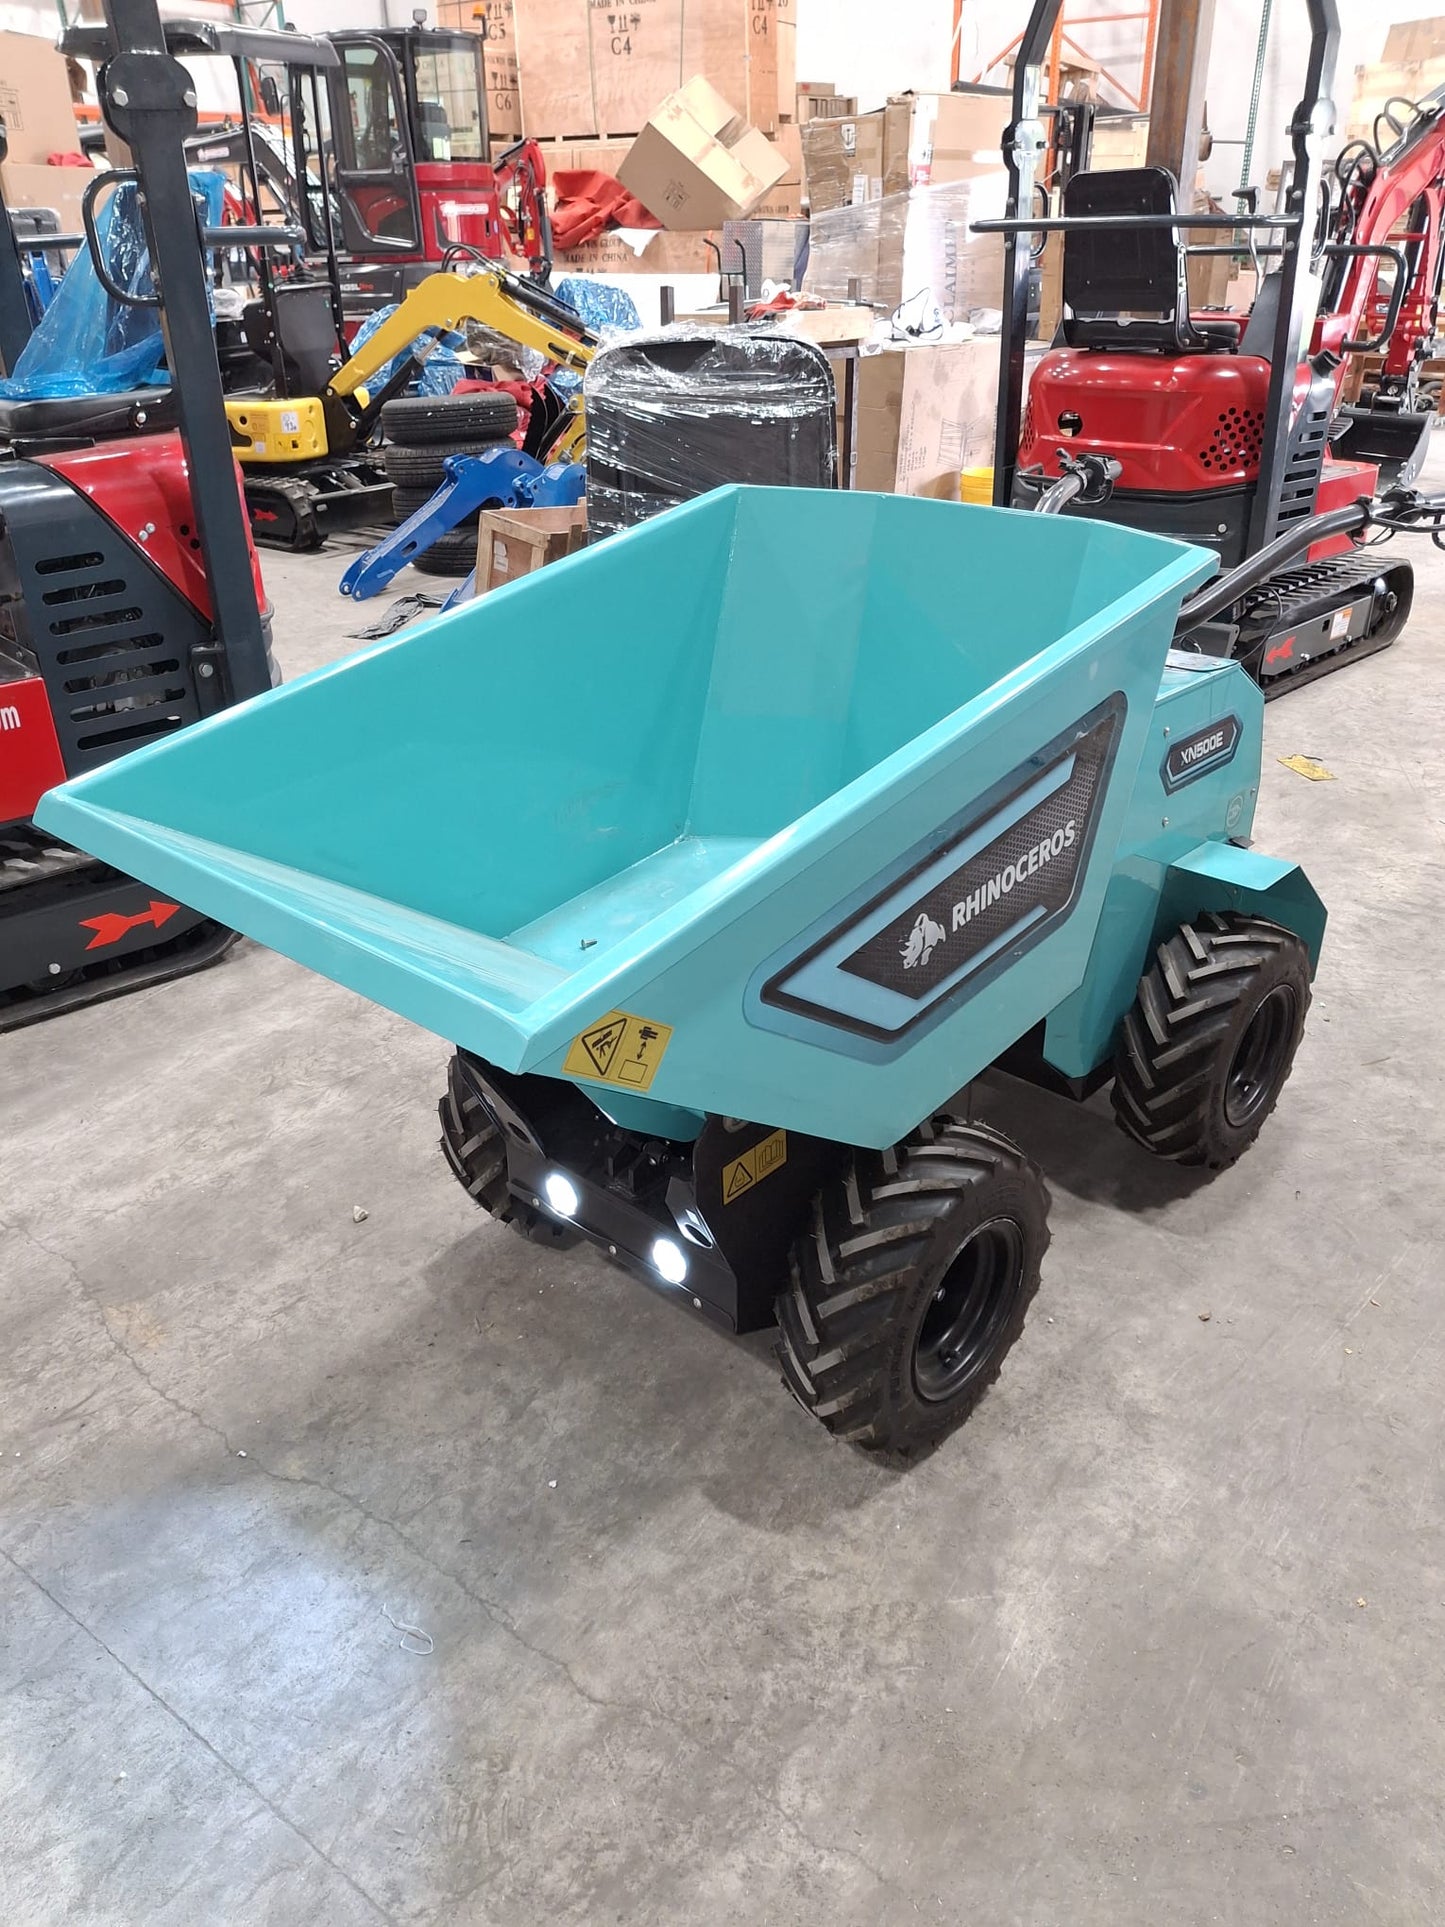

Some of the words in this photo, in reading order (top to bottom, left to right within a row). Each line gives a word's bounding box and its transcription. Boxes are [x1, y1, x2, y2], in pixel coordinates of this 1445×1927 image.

[488, 23, 506, 40] C5
[752, 15, 768, 35] C4
[611, 36, 632, 55] C4
[495, 93, 512, 110] C6
[602, 252, 628, 263] CHINA
[1180, 731, 1224, 766] XN500E
[952, 820, 1076, 932] RHINOCEROS
